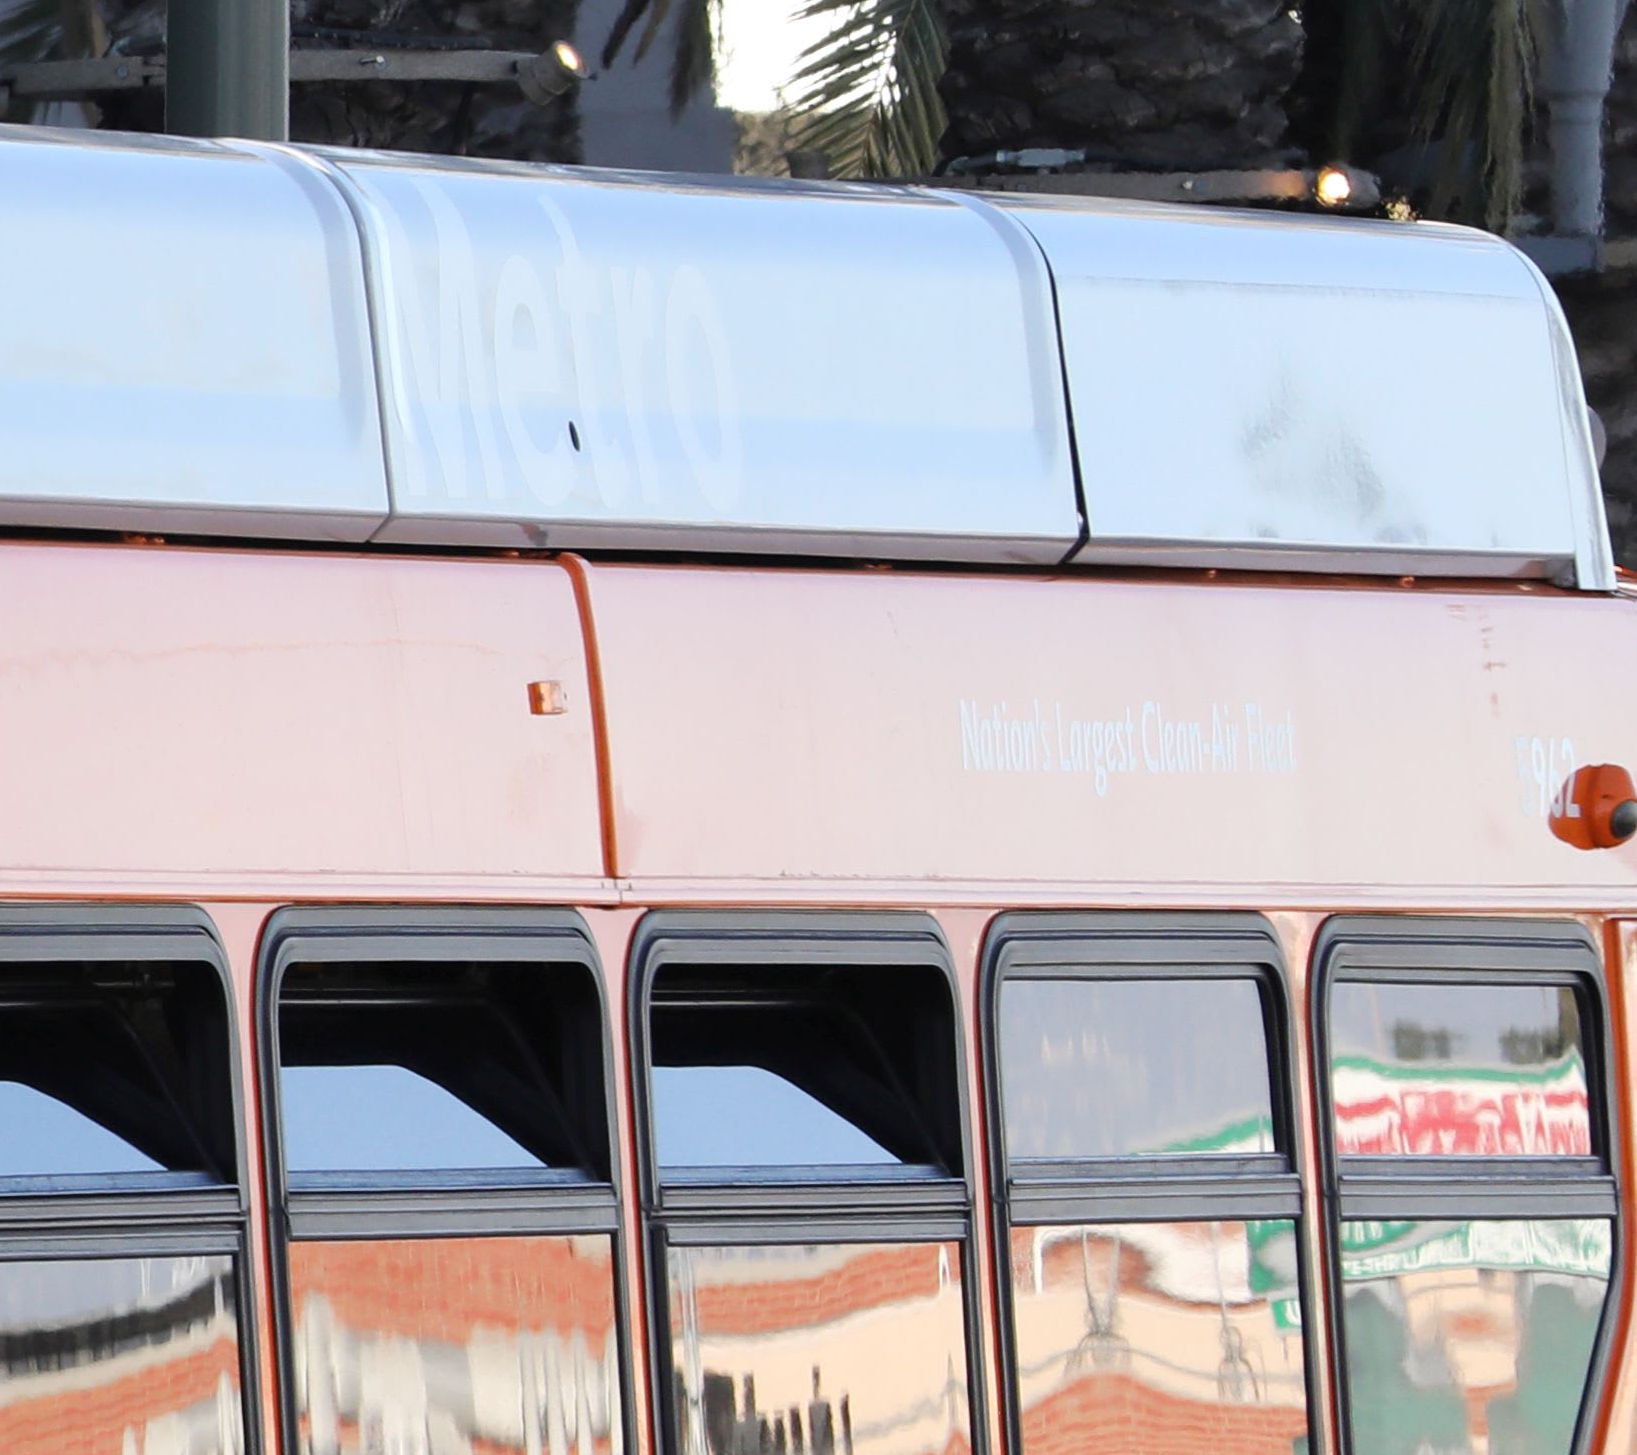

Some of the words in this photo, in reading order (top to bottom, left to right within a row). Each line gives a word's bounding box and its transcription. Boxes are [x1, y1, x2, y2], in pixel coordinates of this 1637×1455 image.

[368, 173, 744, 511] Metro
[959, 697, 1052, 772] Nation's
[1055, 700, 1138, 797] Largest
[1141, 699, 1239, 774] Clean-Air
[1244, 701, 1299, 774] Fleet
[1514, 735, 1583, 818] 5962
